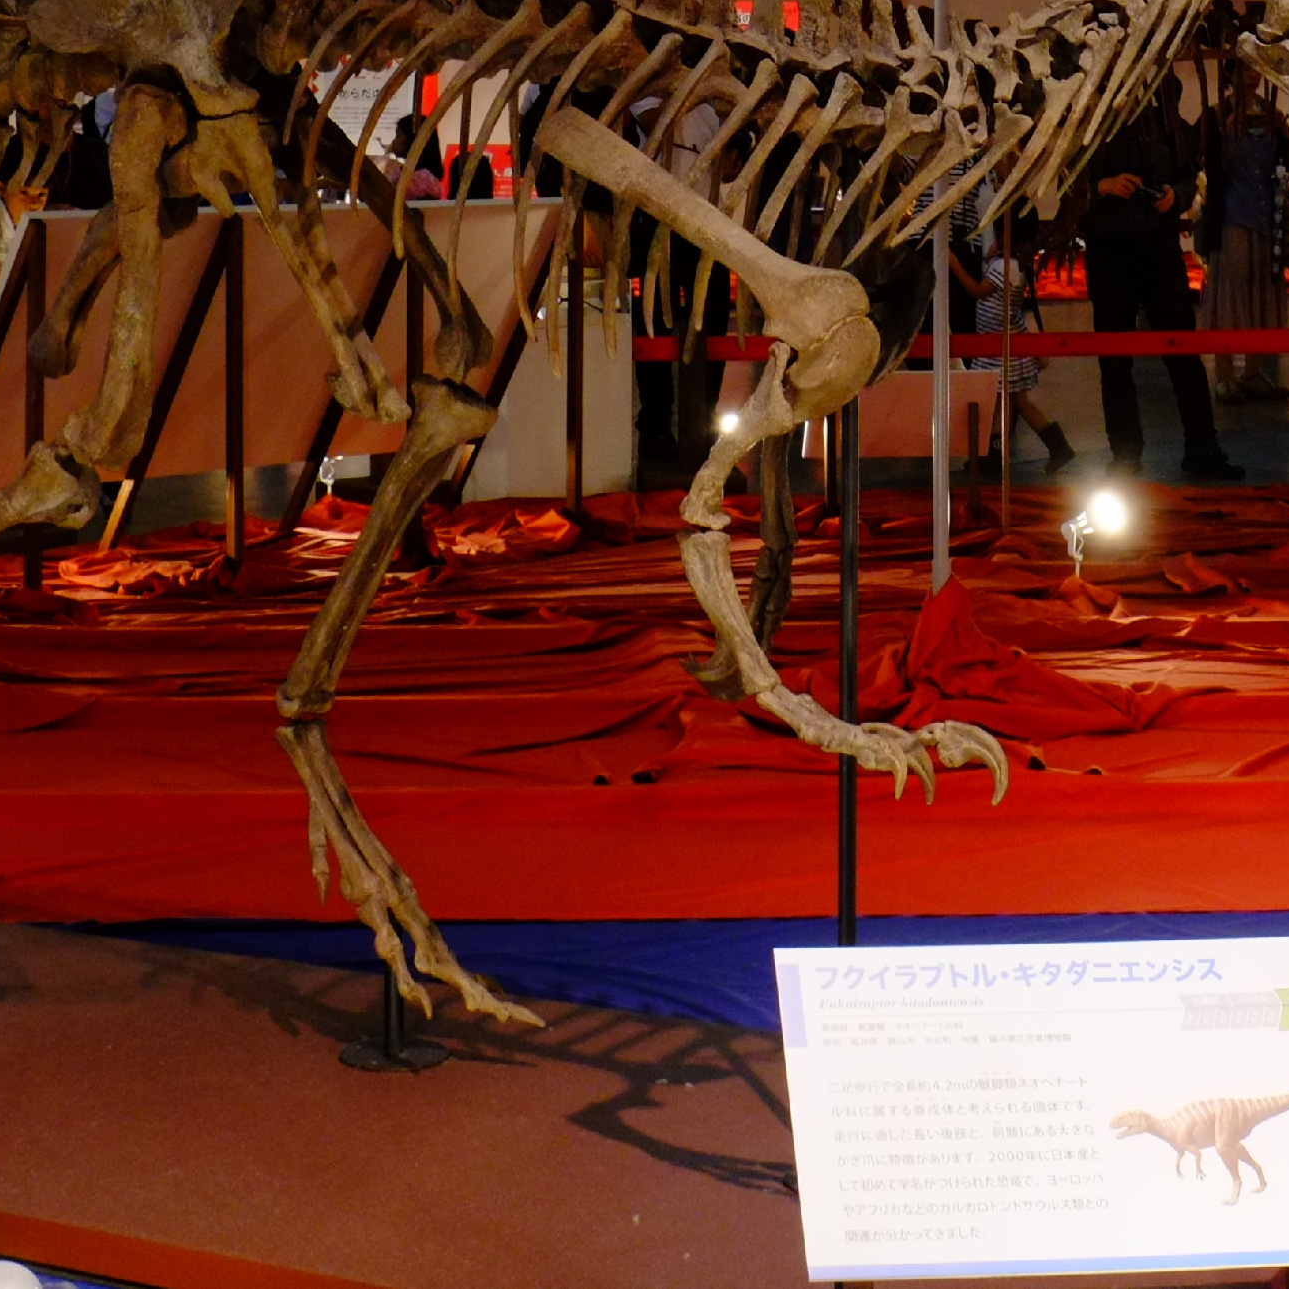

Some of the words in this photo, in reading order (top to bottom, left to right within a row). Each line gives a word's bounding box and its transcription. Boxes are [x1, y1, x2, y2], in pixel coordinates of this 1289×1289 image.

[815, 958, 1222, 990] フクイラプトル・キタダニエンシス
[819, 996, 897, 1012] Fukuiraptor
[901, 994, 985, 1009] kitadaniensis
